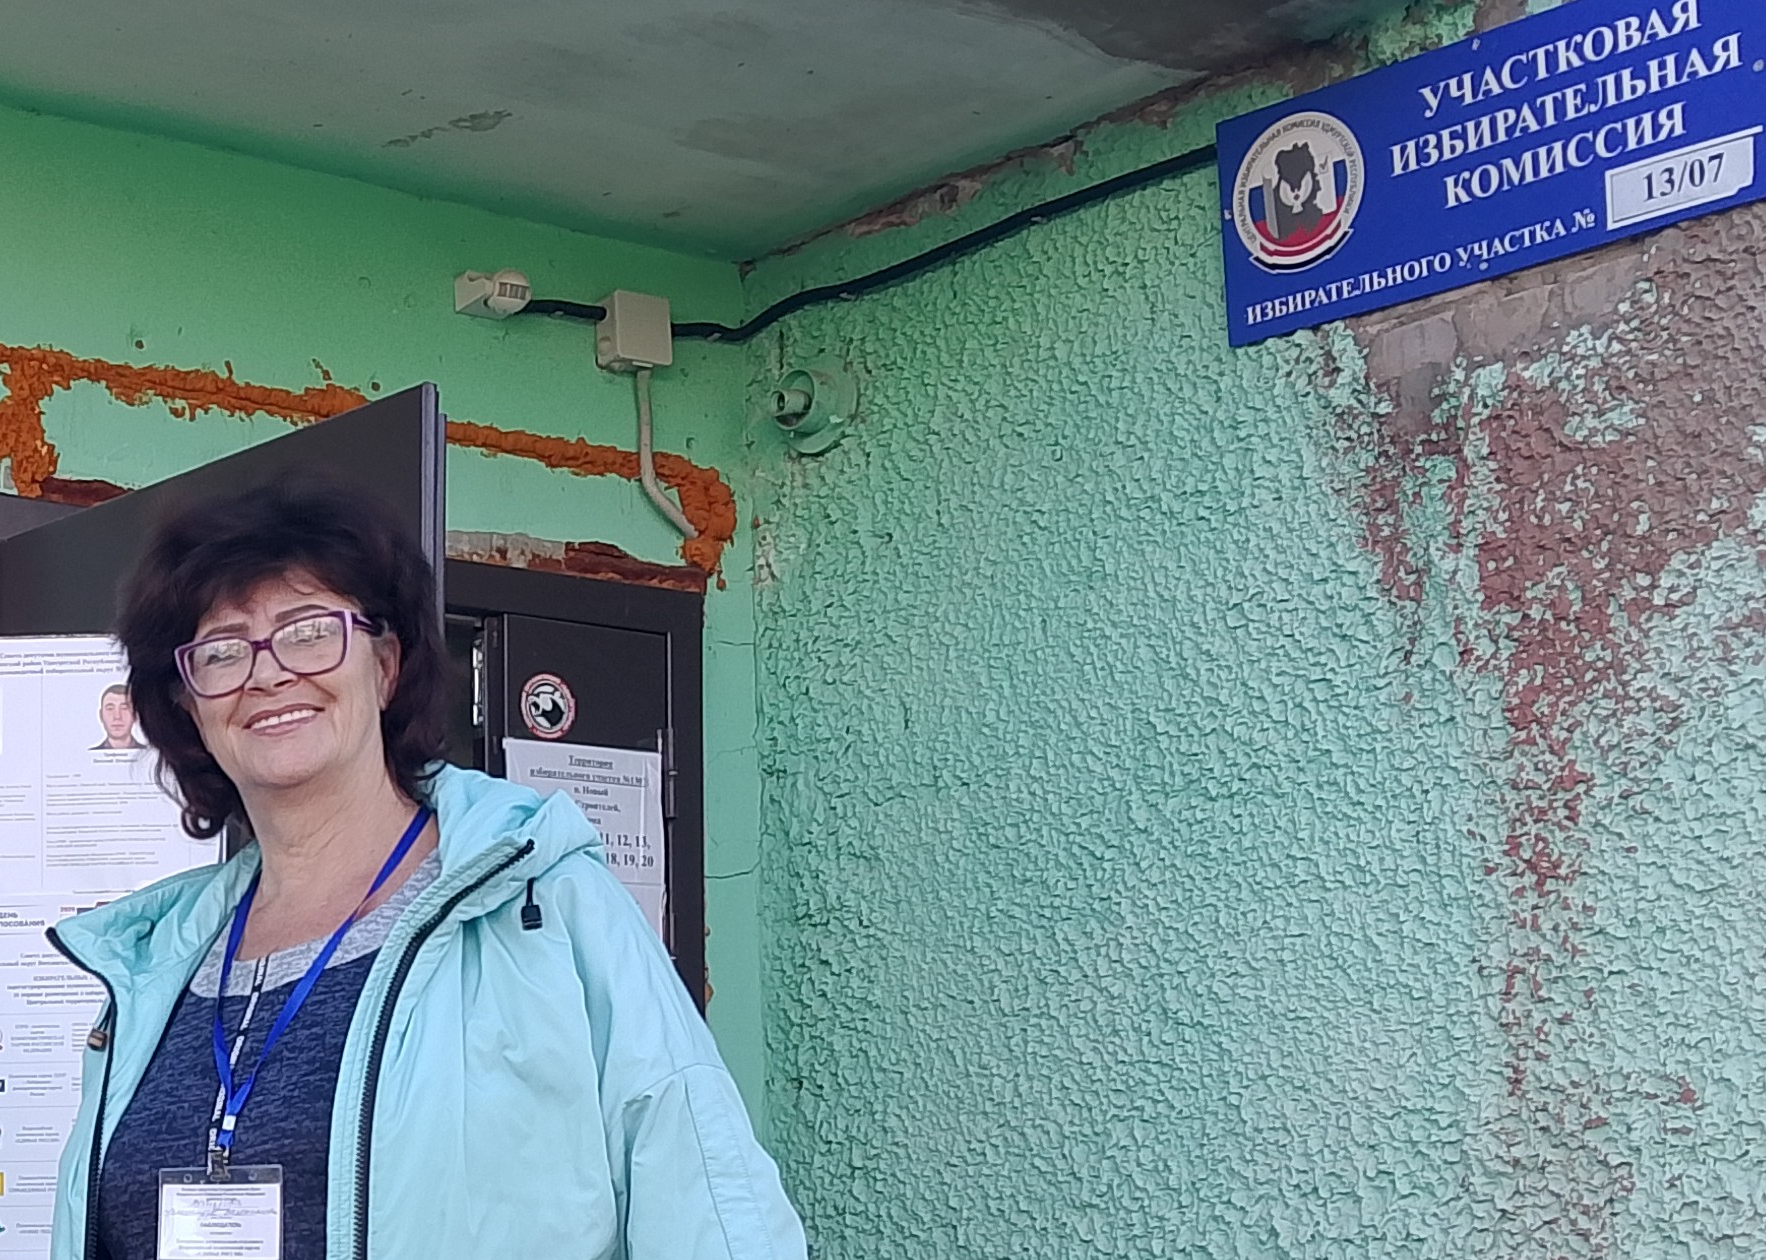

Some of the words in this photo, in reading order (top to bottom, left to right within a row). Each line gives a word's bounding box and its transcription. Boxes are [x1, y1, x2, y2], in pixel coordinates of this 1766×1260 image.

[1390, 32, 1743, 178] ИЗБИРАТЕЛЬНАЯ
[1417, 0, 1703, 118] УЧАСТКОВАЯ
[1443, 101, 1687, 209] КОМИССИЯ
[1246, 253, 1451, 326] ИЗБИРАТЕЛЬНОГО
[1457, 220, 1566, 269] УЧАСТКА
[1571, 208, 1596, 234] №
[1641, 151, 1727, 203] 13/07
[617, 834, 632, 849] 12,
[623, 853, 639, 868] 19,
[641, 854, 654, 867] 20
